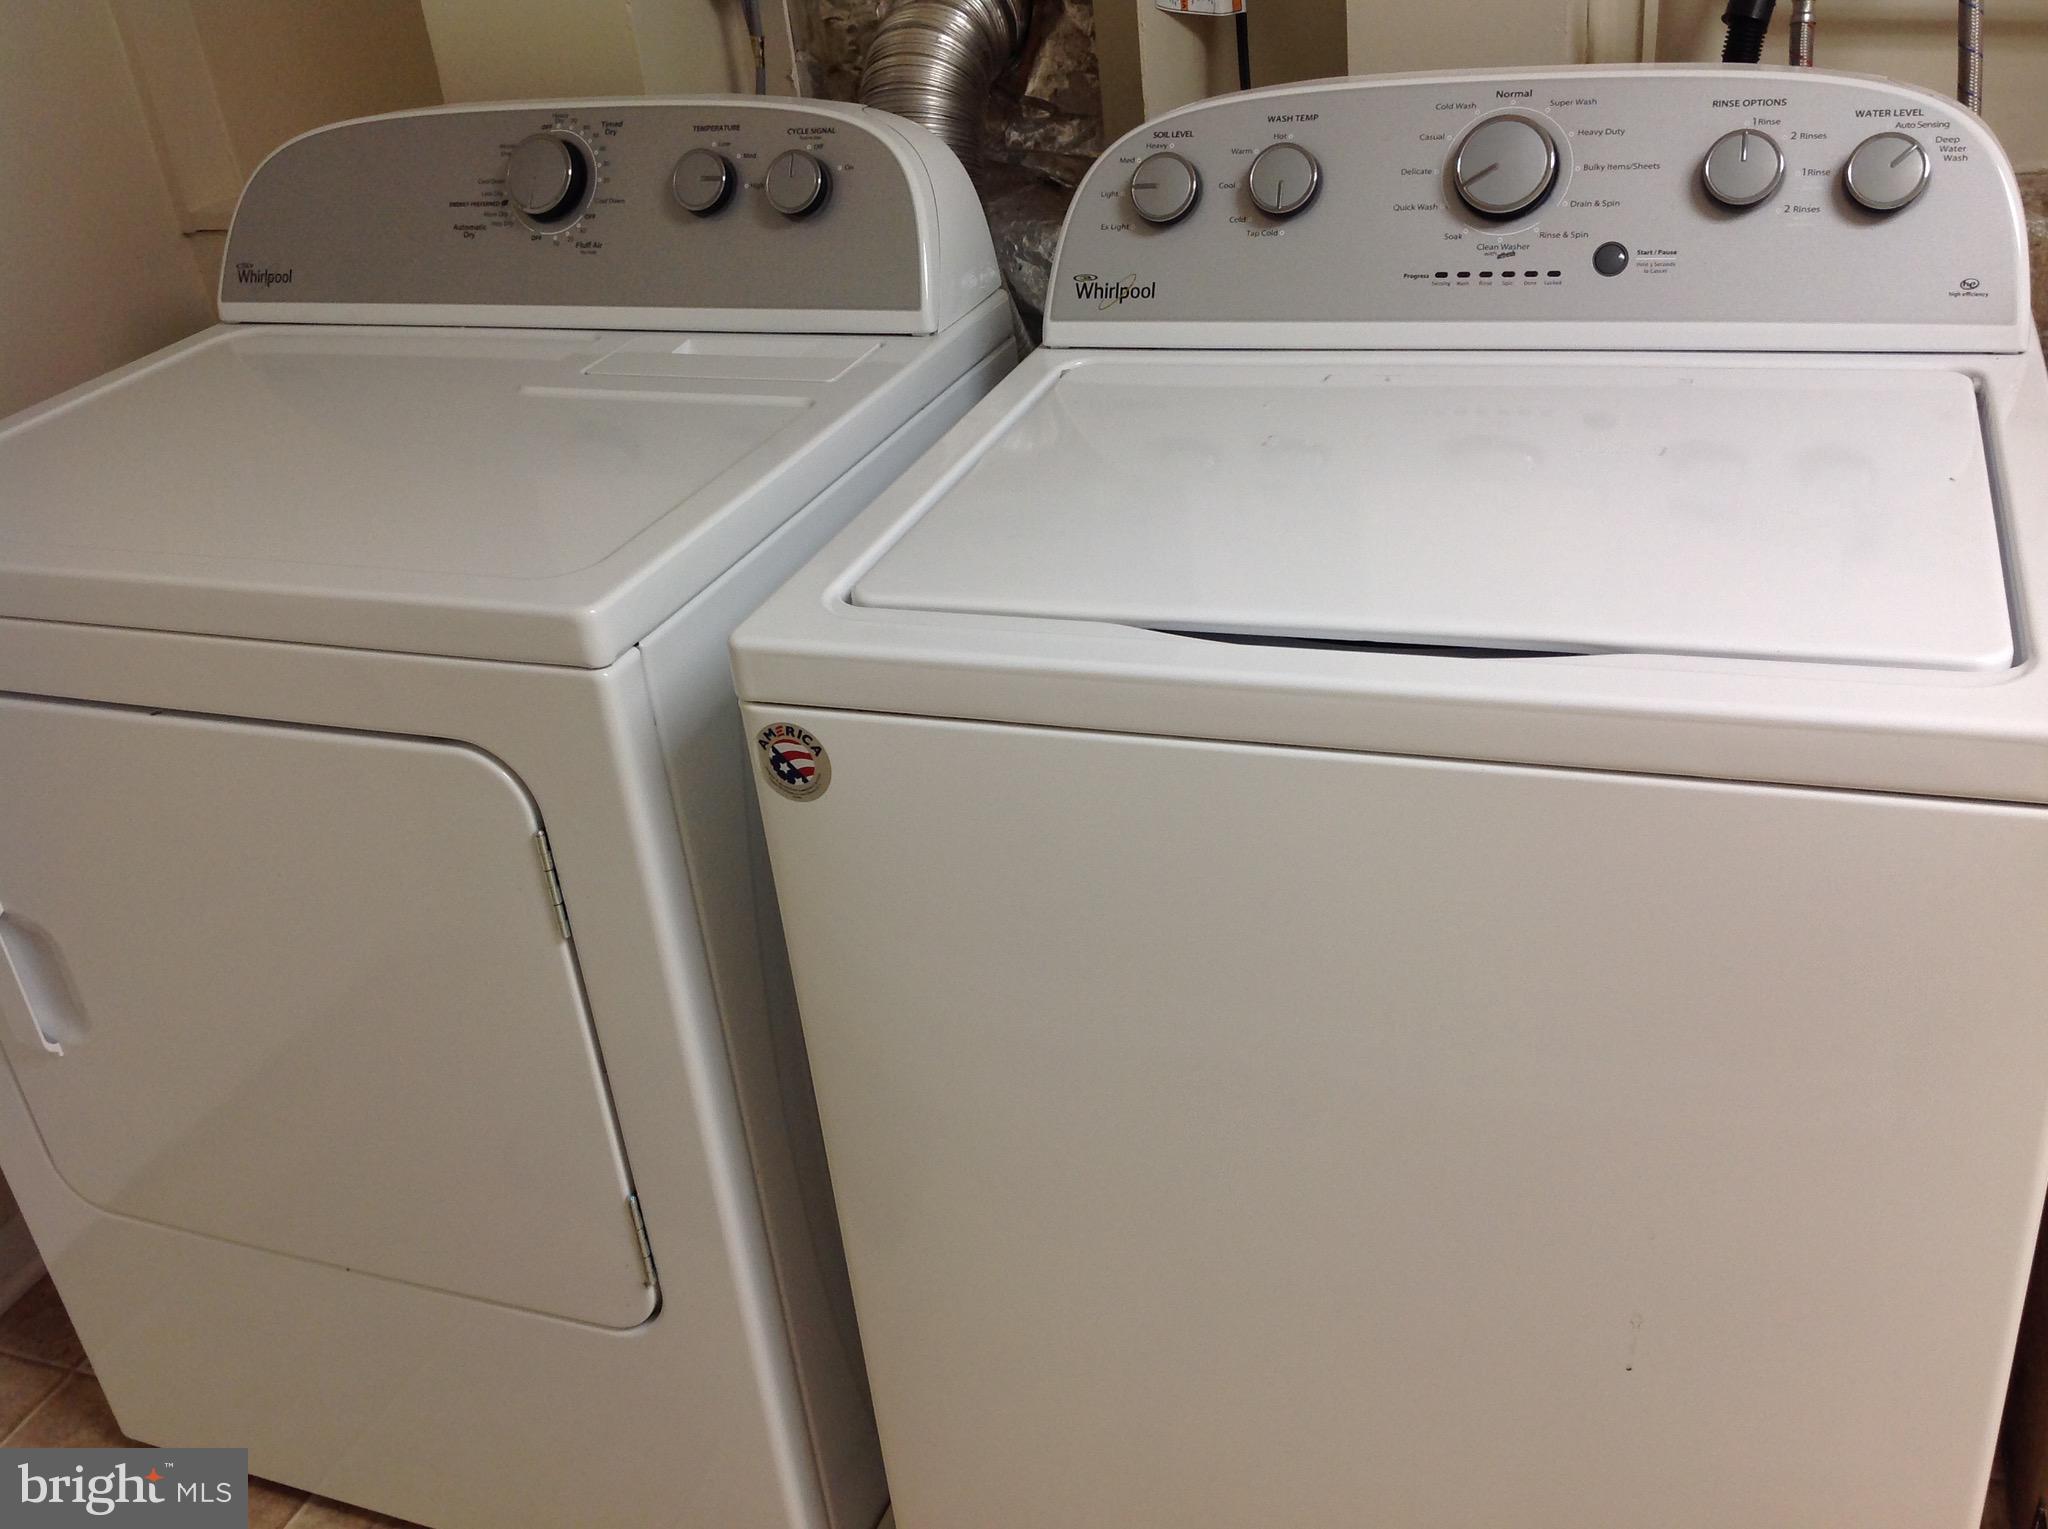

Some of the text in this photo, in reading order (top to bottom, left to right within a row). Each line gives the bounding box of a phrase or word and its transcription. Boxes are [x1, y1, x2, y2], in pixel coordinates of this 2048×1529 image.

[1496, 89, 1533, 98] Normal
[1435, 102, 1477, 111] Cold Wash
[1550, 98, 1598, 108] Super Wash
[1712, 98, 1788, 108] RINSE OPTIONS
[1855, 108, 1924, 118] WATER LEVEL
[1267, 114, 1319, 123] WASH TEMP
[1758, 118, 1782, 126] Rinse
[1895, 120, 1950, 130] Auto Sensing
[604, 128, 617, 136] Dry
[787, 127, 836, 136] CYCLE SIGNAL
[1153, 130, 1194, 139] SOIL LEVEL
[1273, 132, 1287, 140] Hot
[1577, 128, 1626, 138] Heavy Duty
[1790, 131, 1828, 140] 2 Rinses
[1419, 133, 1446, 141] Casual
[1935, 136, 1961, 145] Deep
[1146, 142, 1168, 150] Heavy
[1939, 145, 1967, 153] Water
[1119, 156, 1136, 164] Med
[1943, 154, 1968, 162] Wash
[1400, 167, 1433, 176] Delicate
[1583, 162, 1661, 172] Bulky Items/Sheets
[1807, 168, 1831, 176] Rinse
[1218, 182, 1236, 190] Cool
[1100, 190, 1119, 199] Light
[1392, 202, 1438, 212] Quick Wash
[1570, 200, 1620, 210] Drain & Spin
[1784, 204, 1821, 214] 2 Rinses
[1229, 216, 1247, 224] Cold
[453, 224, 488, 232] Automatic
[1100, 222, 1130, 232] Ex Light
[464, 231, 476, 240] Dry
[1246, 229, 1279, 238] Tap Cold
[1444, 232, 1463, 241] Soak
[1539, 230, 1589, 241] Rinse & Spin
[1476, 242, 1530, 251] Clean Washer
[238, 269, 293, 288] Whirlpool
[1075, 282, 1156, 304] Whirlpool
[758, 726, 822, 757] AMERICA
